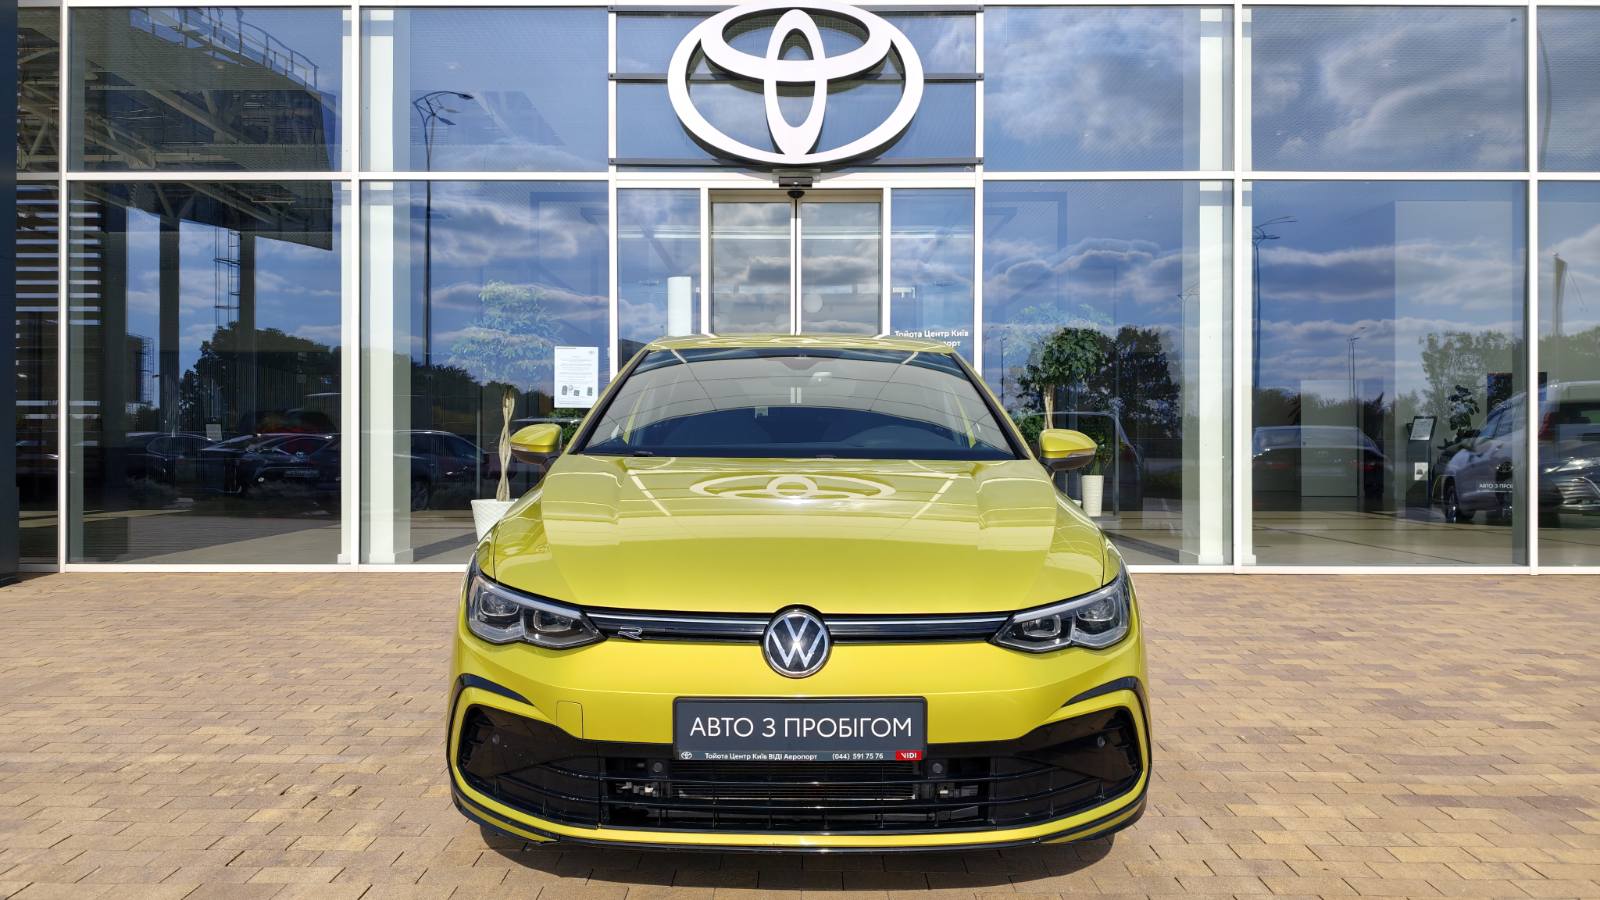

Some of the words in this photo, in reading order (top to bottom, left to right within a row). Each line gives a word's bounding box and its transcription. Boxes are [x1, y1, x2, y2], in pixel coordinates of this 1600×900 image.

[924, 330, 949, 339] Центр
[951, 329, 969, 337] Київ
[689, 716, 754, 738] АВТО
[761, 716, 776, 738] З
[784, 716, 912, 738] ПРОБІГОМ
[704, 752, 728, 760] Тойота
[729, 752, 751, 761] Центр
[752, 752, 767, 760] Київ
[783, 753, 817, 761] Аеропорт
[832, 752, 850, 761] (044)
[852, 752, 864, 760] 591
[865, 752, 874, 760] 75
[875, 752, 884, 760] 76
[900, 752, 917, 760] VIDI
